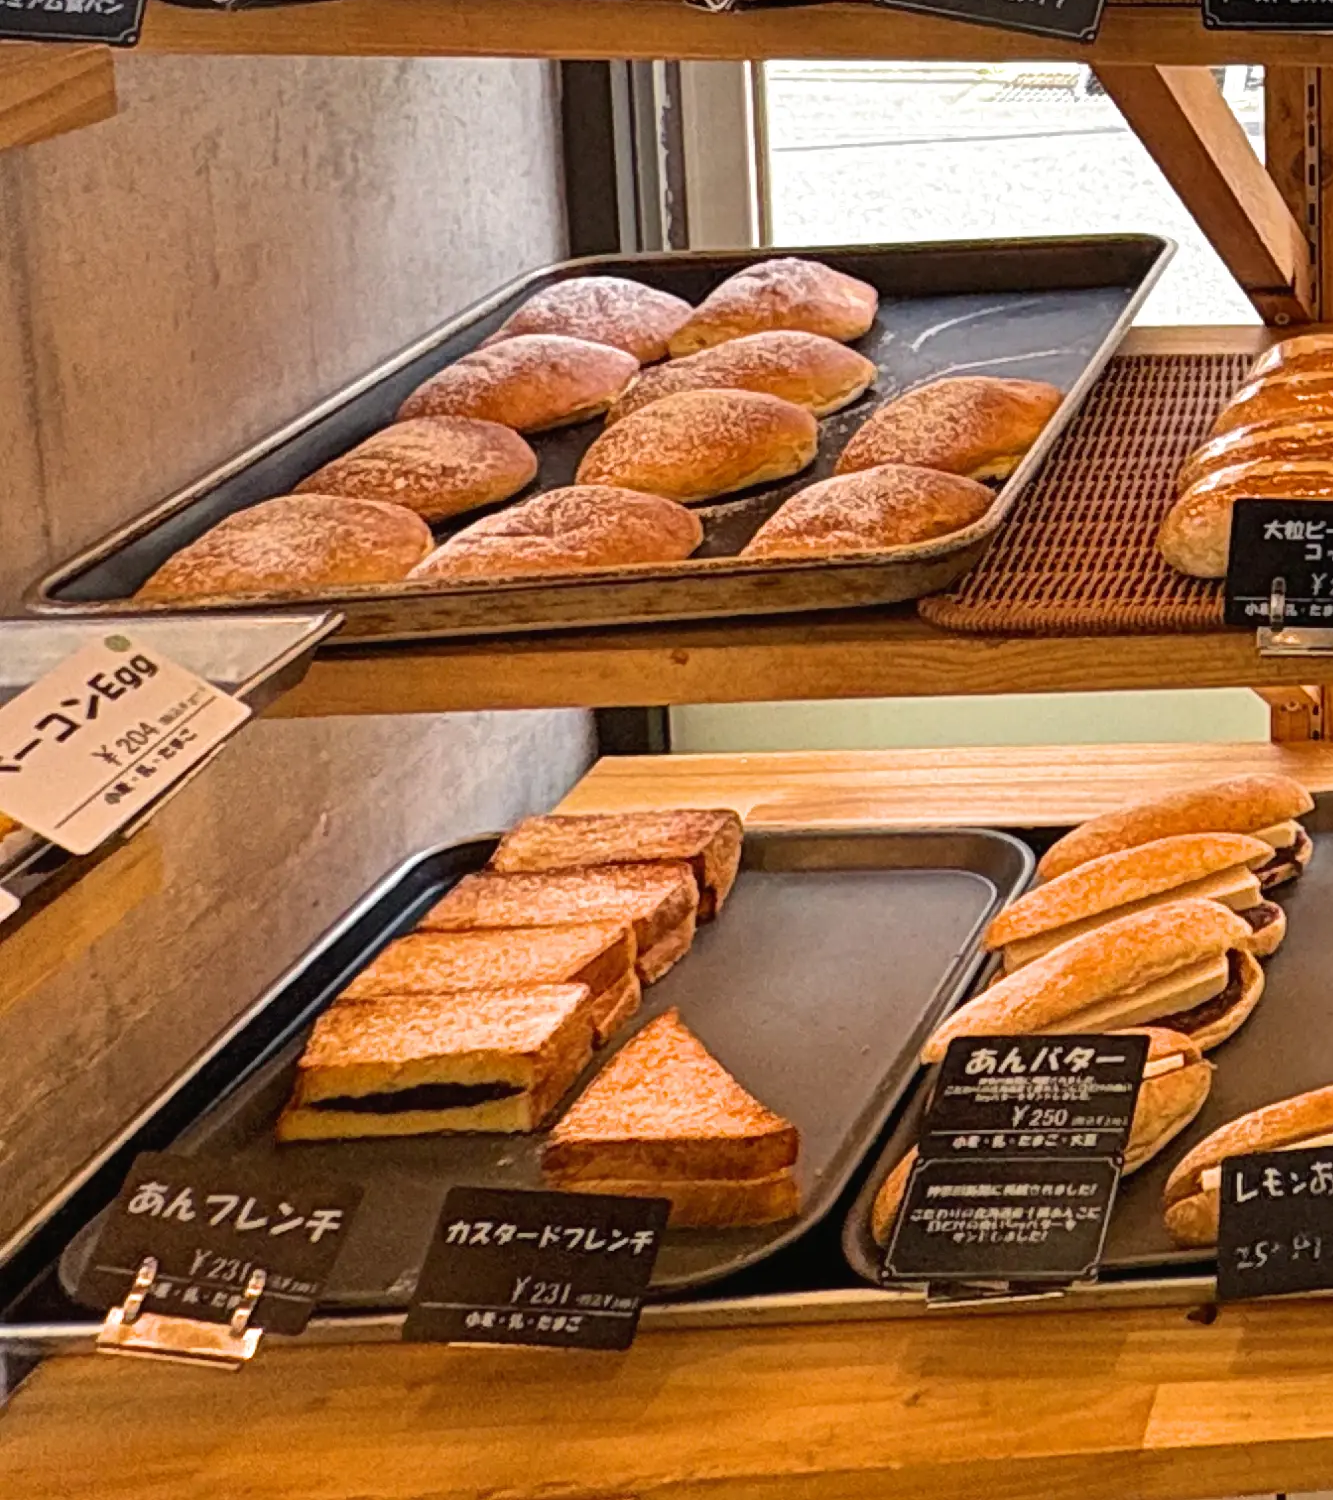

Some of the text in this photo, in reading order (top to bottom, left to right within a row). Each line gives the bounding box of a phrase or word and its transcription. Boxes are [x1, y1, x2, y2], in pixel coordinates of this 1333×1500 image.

[91, 721, 159, 768] ¥204
[964, 1046, 1127, 1075] あんバター
[1011, 1105, 1069, 1130] ¥250
[127, 1180, 343, 1244] あんフレンチ
[445, 1219, 655, 1255] カスタードフレンチ
[510, 1275, 573, 1305] ¥231
